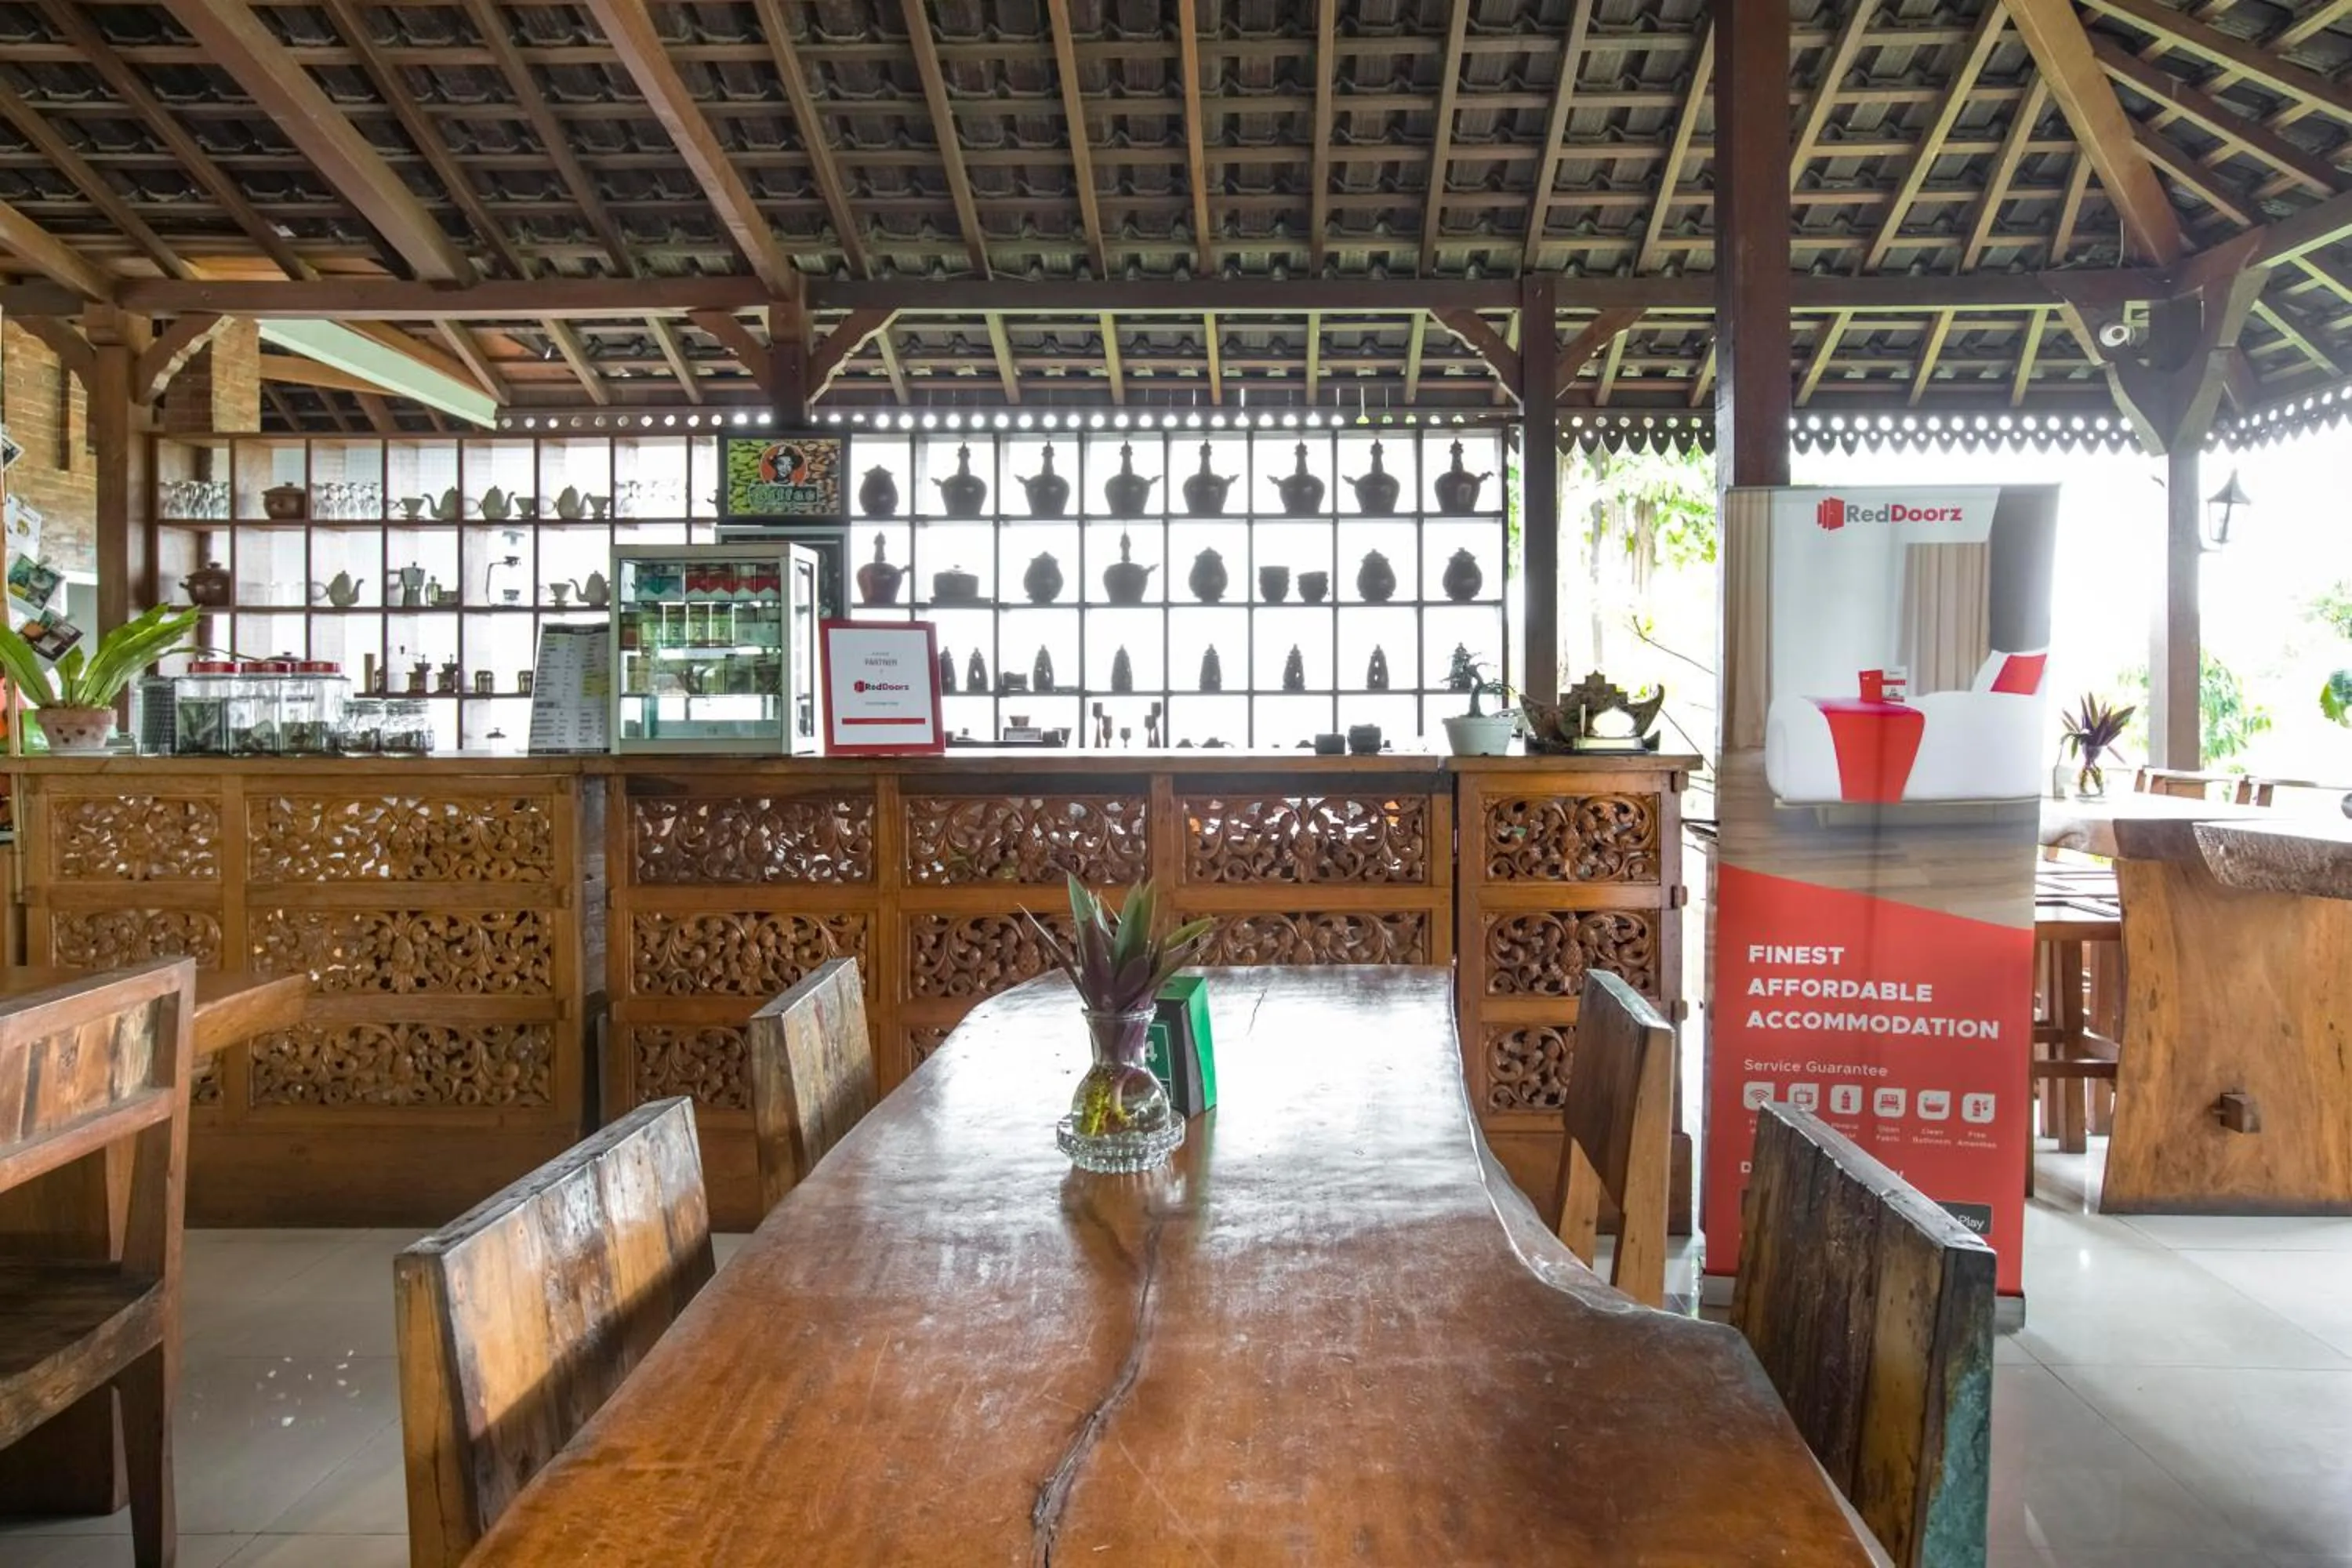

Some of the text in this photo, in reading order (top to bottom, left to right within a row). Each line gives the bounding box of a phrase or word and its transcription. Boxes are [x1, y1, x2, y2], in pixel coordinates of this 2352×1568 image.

[1846, 503, 1962, 522] RedDoorz
[1748, 945, 1844, 964] FINEST
[1748, 978, 1933, 1002] AFFORDABLE
[1746, 1010, 1999, 1039] ACCOMMODATION
[1744, 1059, 1888, 1077] Service Guarantee
[1958, 1215, 1985, 1230] Play
